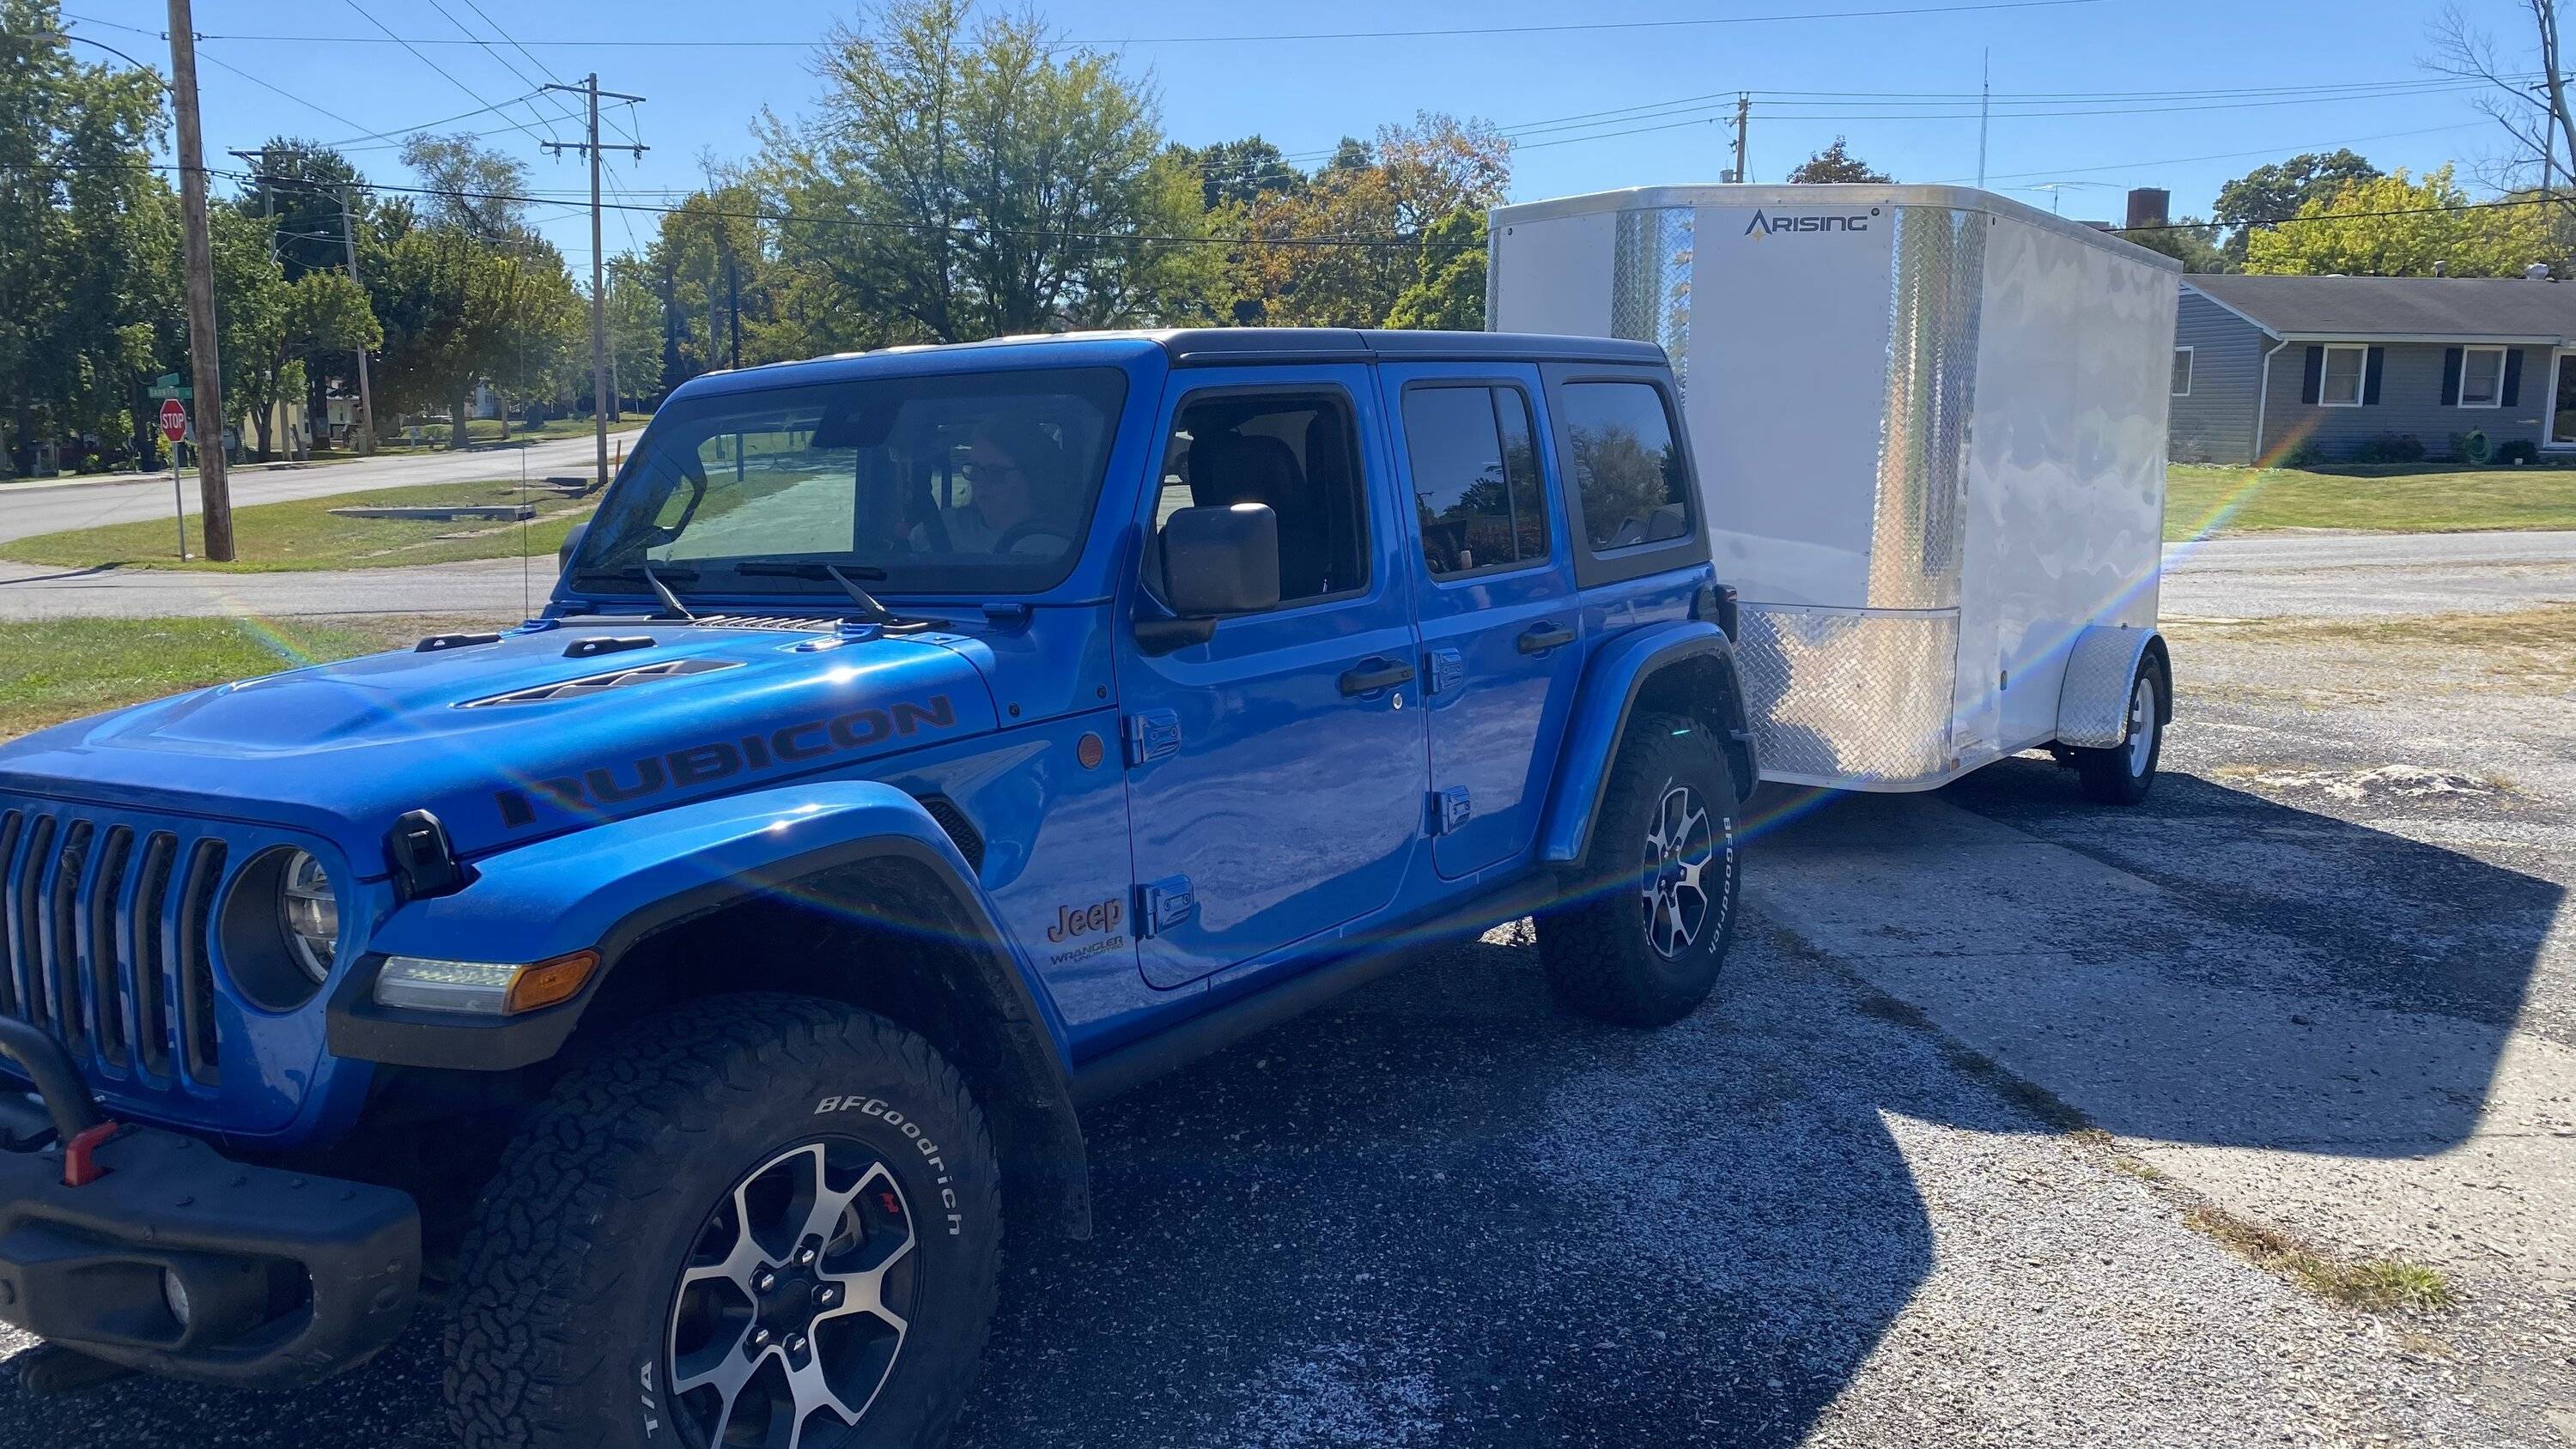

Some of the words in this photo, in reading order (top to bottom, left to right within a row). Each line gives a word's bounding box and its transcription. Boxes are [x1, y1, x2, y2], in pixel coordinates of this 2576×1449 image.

[1744, 209, 1868, 235] ARISING
[162, 413, 185, 429] STOP
[494, 694, 957, 828] RUBICON
[1709, 817, 1733, 955] BFGoodrich
[1048, 898, 1124, 943] Jeep
[1050, 936, 1123, 965] WRANGLER
[813, 1095, 962, 1235] BFGoodrich
[641, 1361, 659, 1439] T/A
